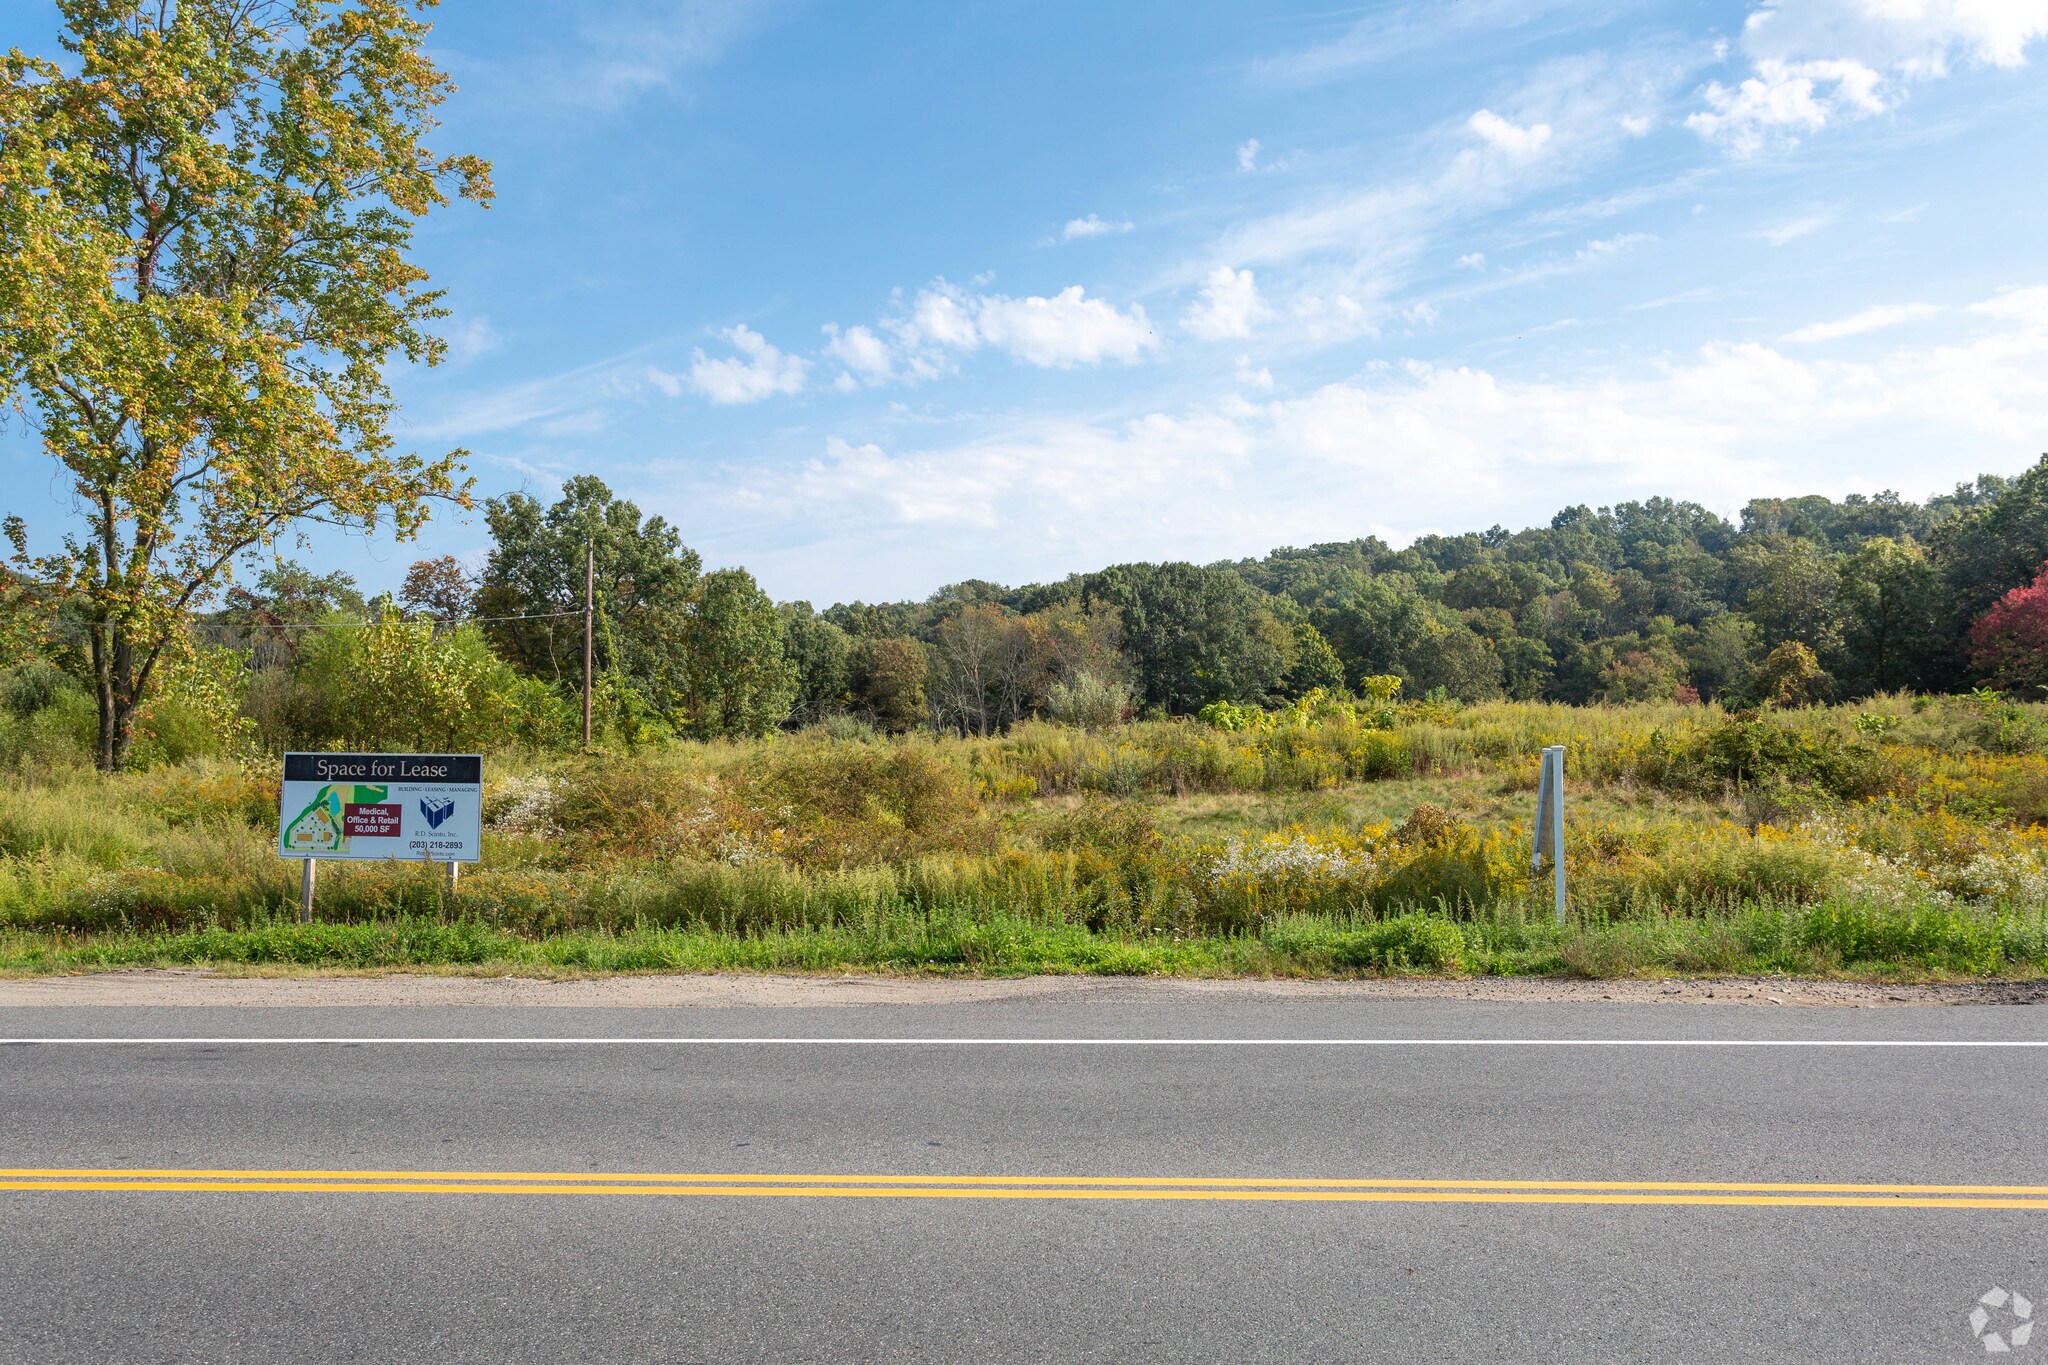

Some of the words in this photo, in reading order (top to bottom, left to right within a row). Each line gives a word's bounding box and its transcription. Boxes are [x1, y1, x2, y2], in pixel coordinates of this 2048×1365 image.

[317, 759, 366, 780] Space
[370, 759, 395, 776] for
[400, 760, 448, 776] Lease
[359, 807, 389, 816] Medical,
[347, 816, 368, 824] Office
[370, 816, 376, 824] &
[378, 816, 399, 824] Retail
[354, 825, 378, 833] 50,000
[379, 825, 390, 833] SF
[409, 840, 428, 849] (203)
[430, 841, 463, 849] 218-2893
